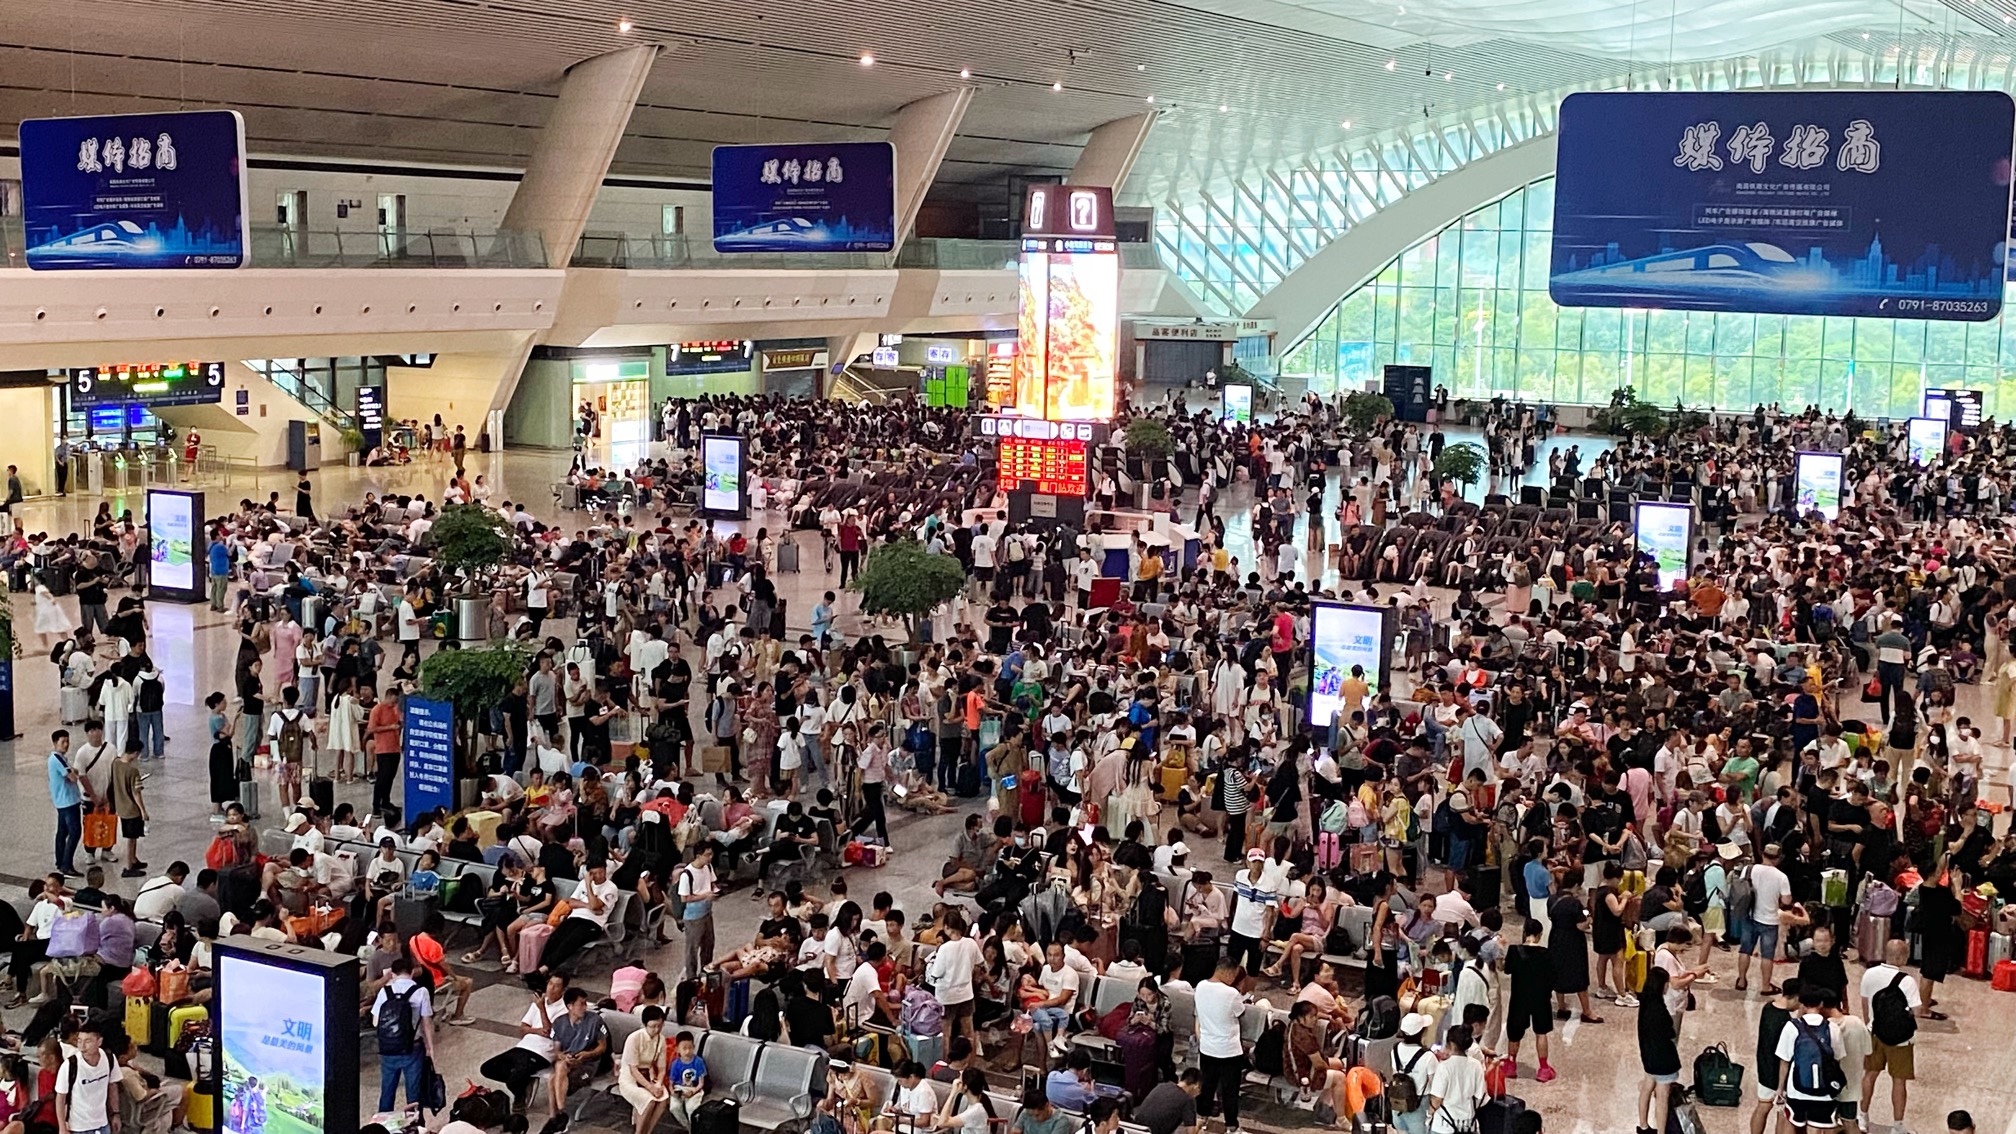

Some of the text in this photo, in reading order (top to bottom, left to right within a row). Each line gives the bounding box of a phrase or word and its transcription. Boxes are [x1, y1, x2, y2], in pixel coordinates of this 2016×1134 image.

[77, 132, 178, 174] 媒体招商
[1674, 119, 1881, 174] 媒体招商
[760, 156, 844, 185] 媒体招商
[1897, 298, 1988, 313] 0791-87035263
[77, 369, 92, 393] 5
[207, 363, 221, 386] 5
[1352, 635, 1374, 646] 文明
[281, 1017, 313, 1042] 文明
